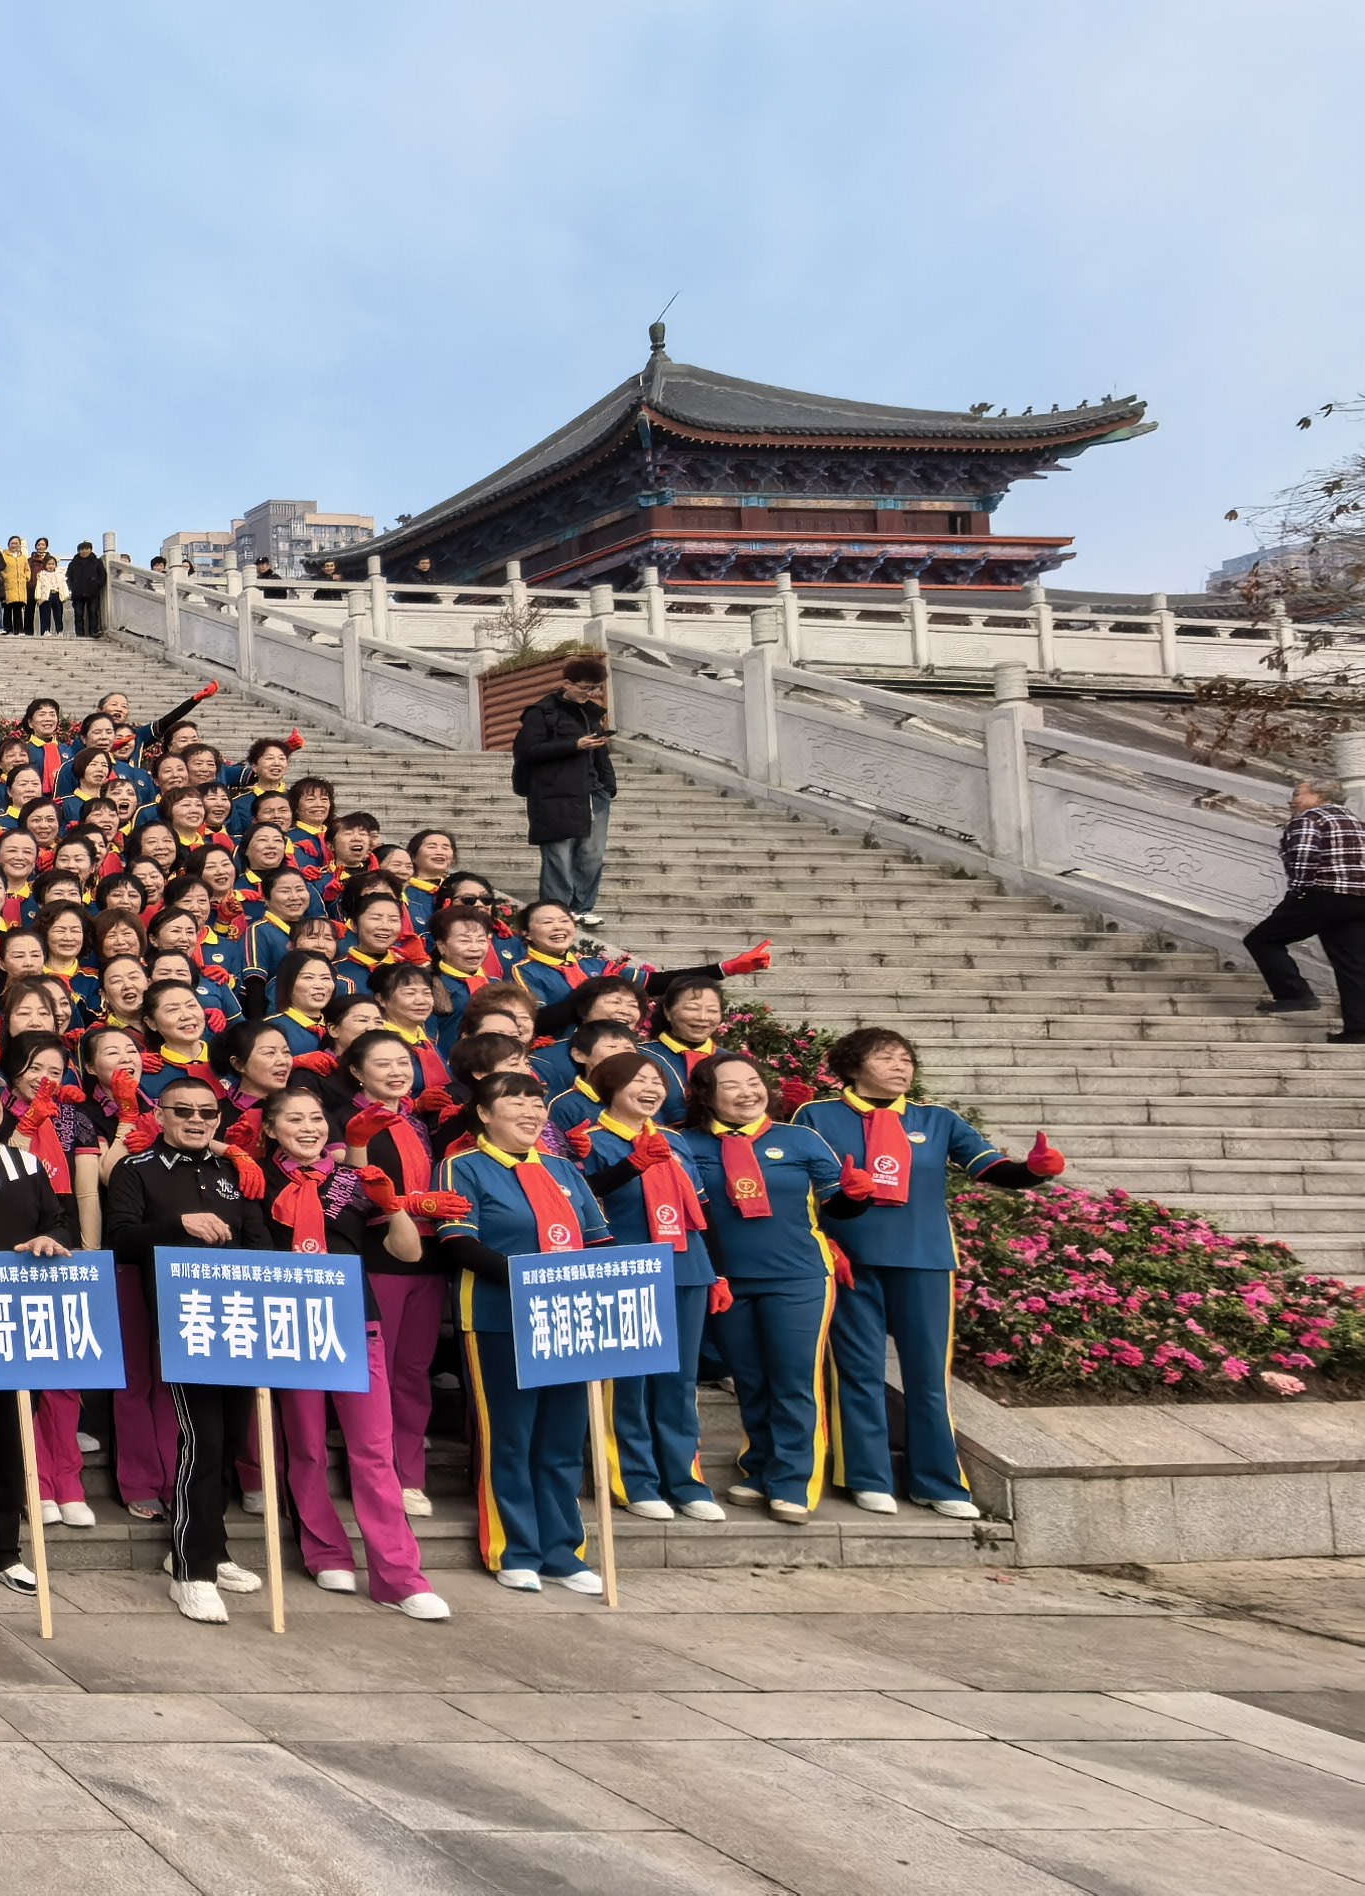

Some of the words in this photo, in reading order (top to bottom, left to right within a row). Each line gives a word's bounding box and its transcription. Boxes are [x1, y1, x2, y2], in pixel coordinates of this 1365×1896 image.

[170, 1261, 346, 1286] 四川省佳木斯操队联合举办春节联欢会
[521, 1258, 662, 1286] 四川省佳木斯操队联合举办春节联欢会
[178, 1288, 347, 1364] 春春团队
[528, 1284, 662, 1361] 海润滨江团队
